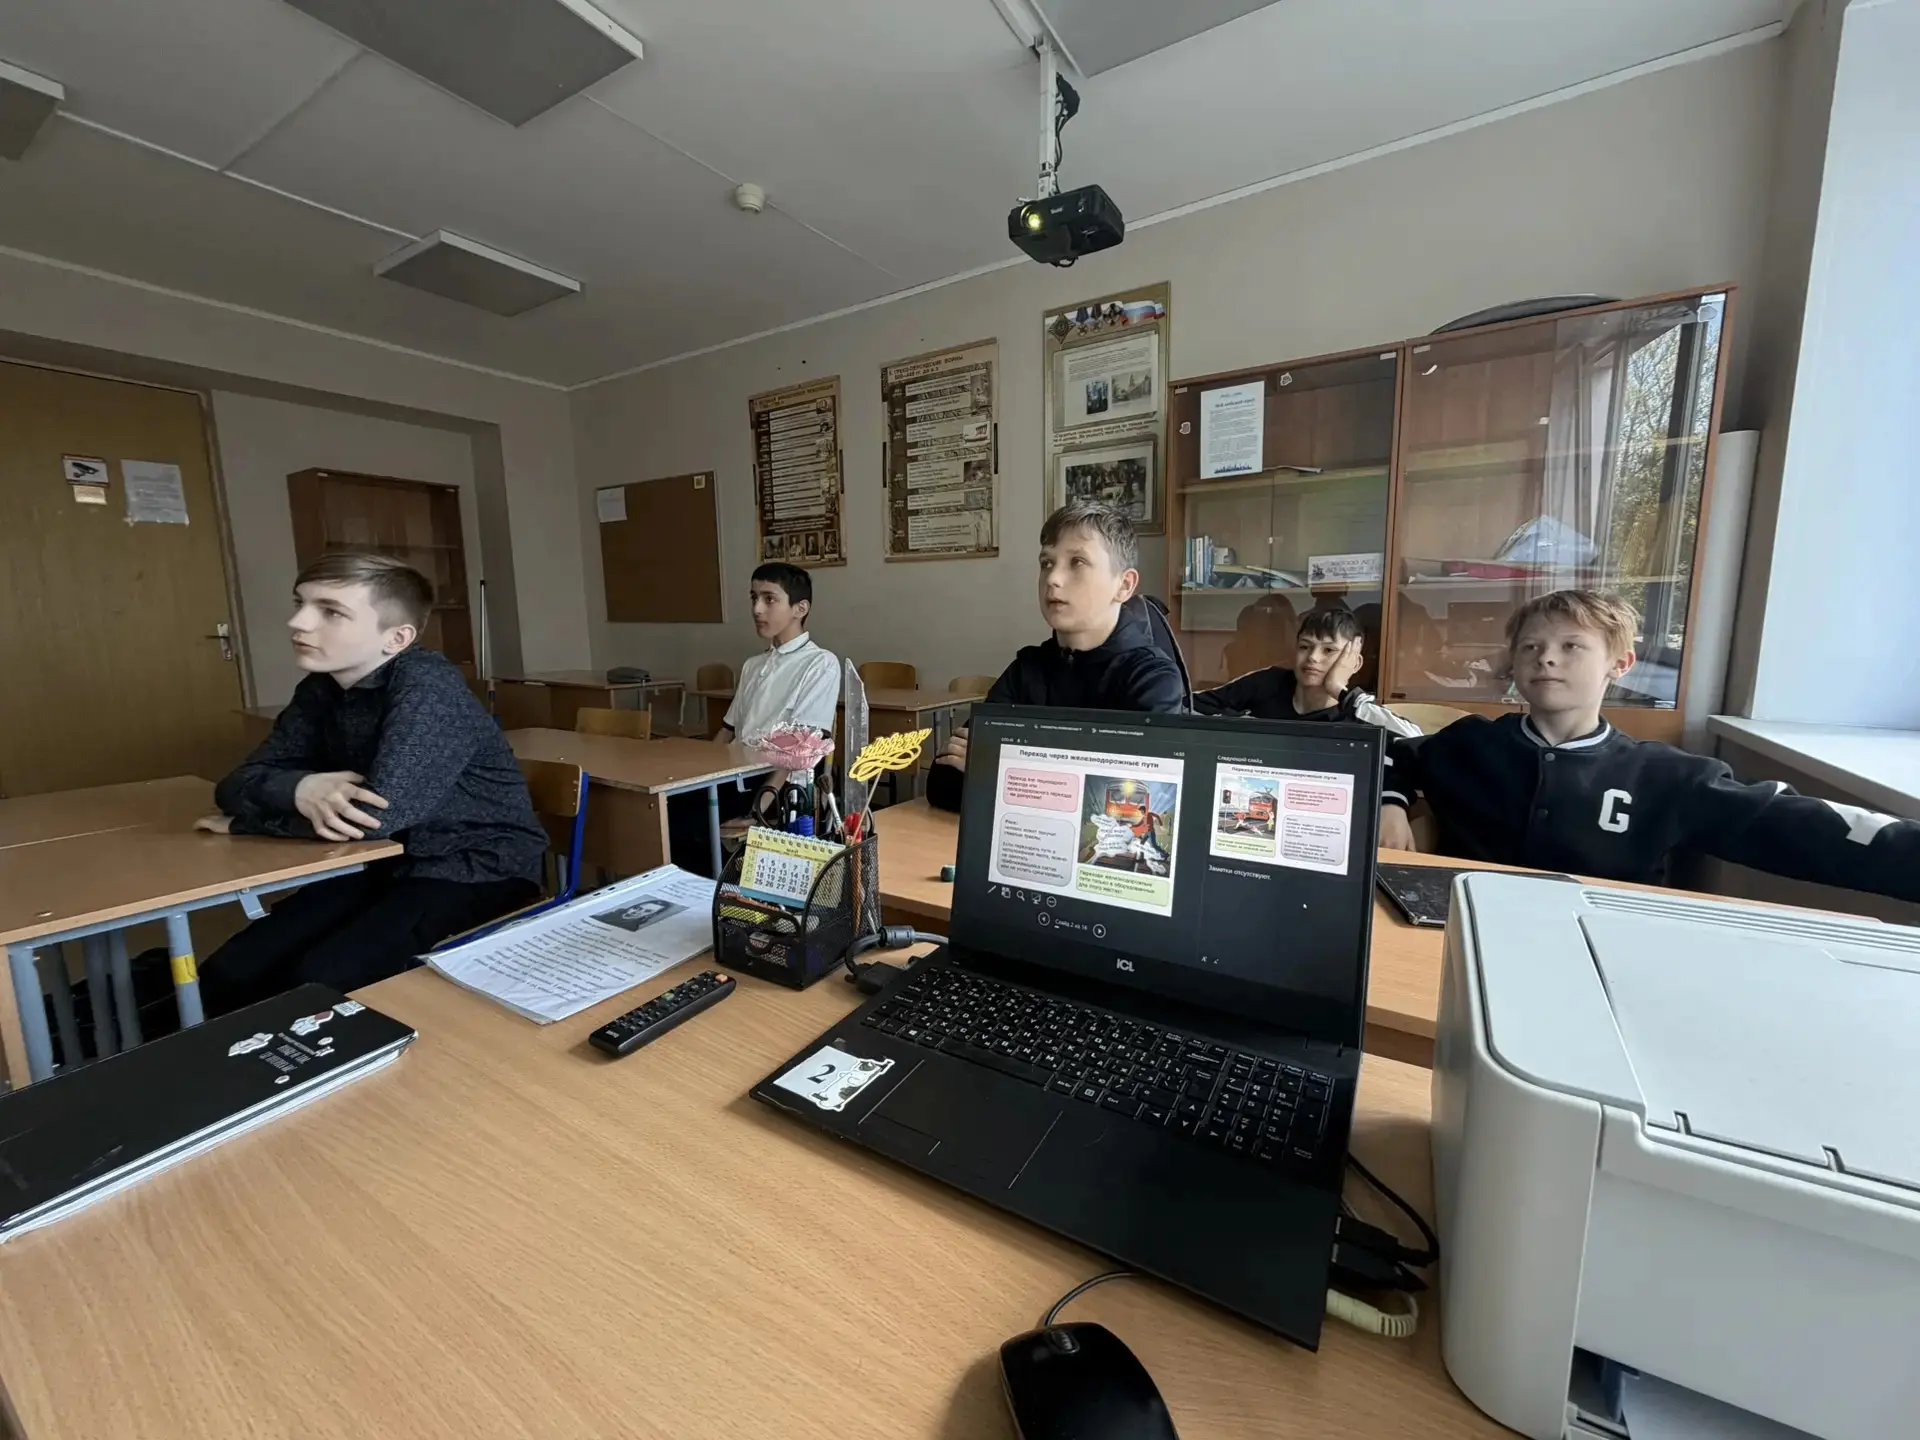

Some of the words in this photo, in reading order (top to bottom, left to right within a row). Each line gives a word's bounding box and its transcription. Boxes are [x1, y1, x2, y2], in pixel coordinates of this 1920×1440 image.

[1020, 750, 1047, 759] Переход
[1070, 755, 1140, 767] железнодорожные
[1141, 761, 1159, 769] пути
[1598, 788, 1632, 833] G
[1208, 865, 1233, 874] Заметки
[1234, 869, 1271, 880] отсутствуют.
[1055, 918, 1070, 928] Слайд
[1116, 958, 1135, 972] ICL
[806, 1064, 836, 1084] 2
